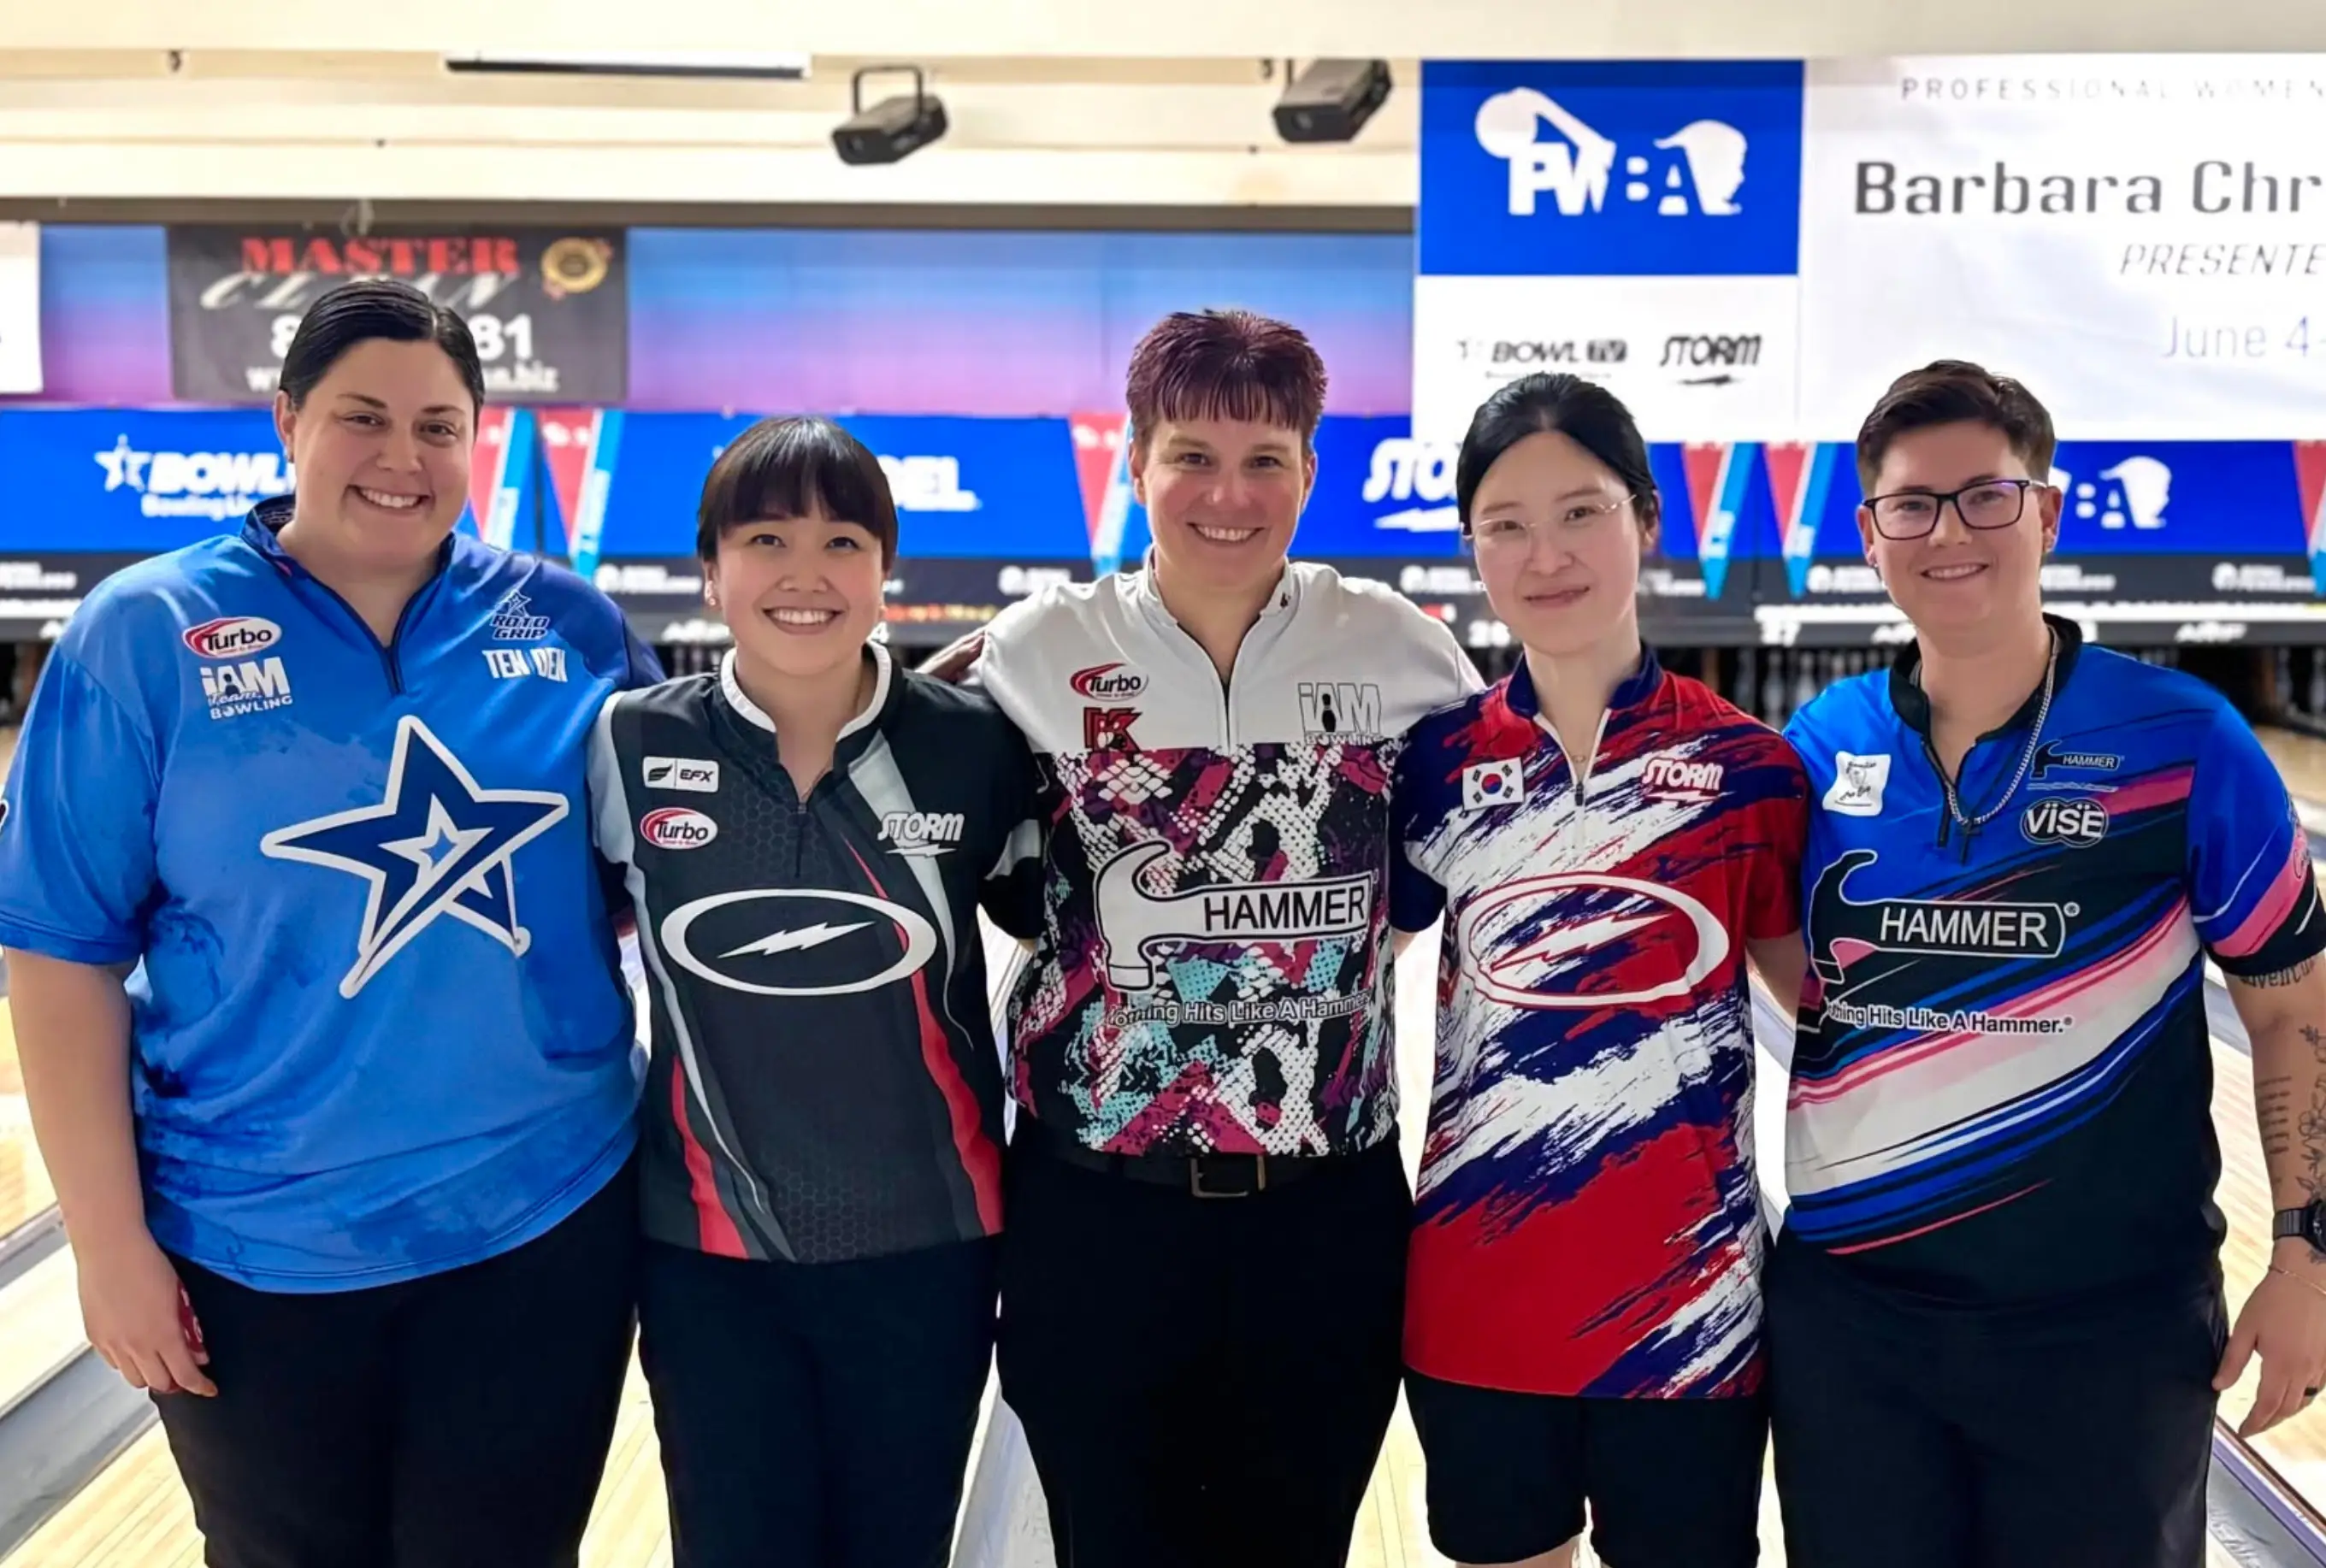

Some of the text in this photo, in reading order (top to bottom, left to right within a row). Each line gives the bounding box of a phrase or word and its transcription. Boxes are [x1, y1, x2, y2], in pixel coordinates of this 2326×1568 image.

[1855, 160, 2163, 215] Barbara
[240, 237, 520, 274] MASTER
[2161, 315, 2268, 358] June
[1491, 340, 1581, 363] BOWL
[1659, 333, 1762, 367] STORM
[1361, 437, 1458, 503] STO
[491, 614, 550, 628] ROTO
[493, 628, 548, 640] GRIP
[202, 628, 273, 651] Turbo
[1089, 674, 1142, 693] Turbo
[210, 694, 293, 720] BOWLING
[2062, 754, 2116, 768] HAMMER
[679, 768, 715, 783] EFX
[1642, 758, 1724, 791] STORM
[655, 820, 709, 840] Turbo
[877, 811, 965, 841] STORM
[1203, 884, 1366, 932] HAMMER
[1880, 906, 2049, 948] HAMMER
[1184, 1002, 1226, 1022] Hits
[1230, 999, 1277, 1021] Like
[1281, 998, 1299, 1020] A
[1868, 1005, 1904, 1028] Hits
[1908, 1011, 1949, 1030] Like
[1953, 1014, 1968, 1031] A
